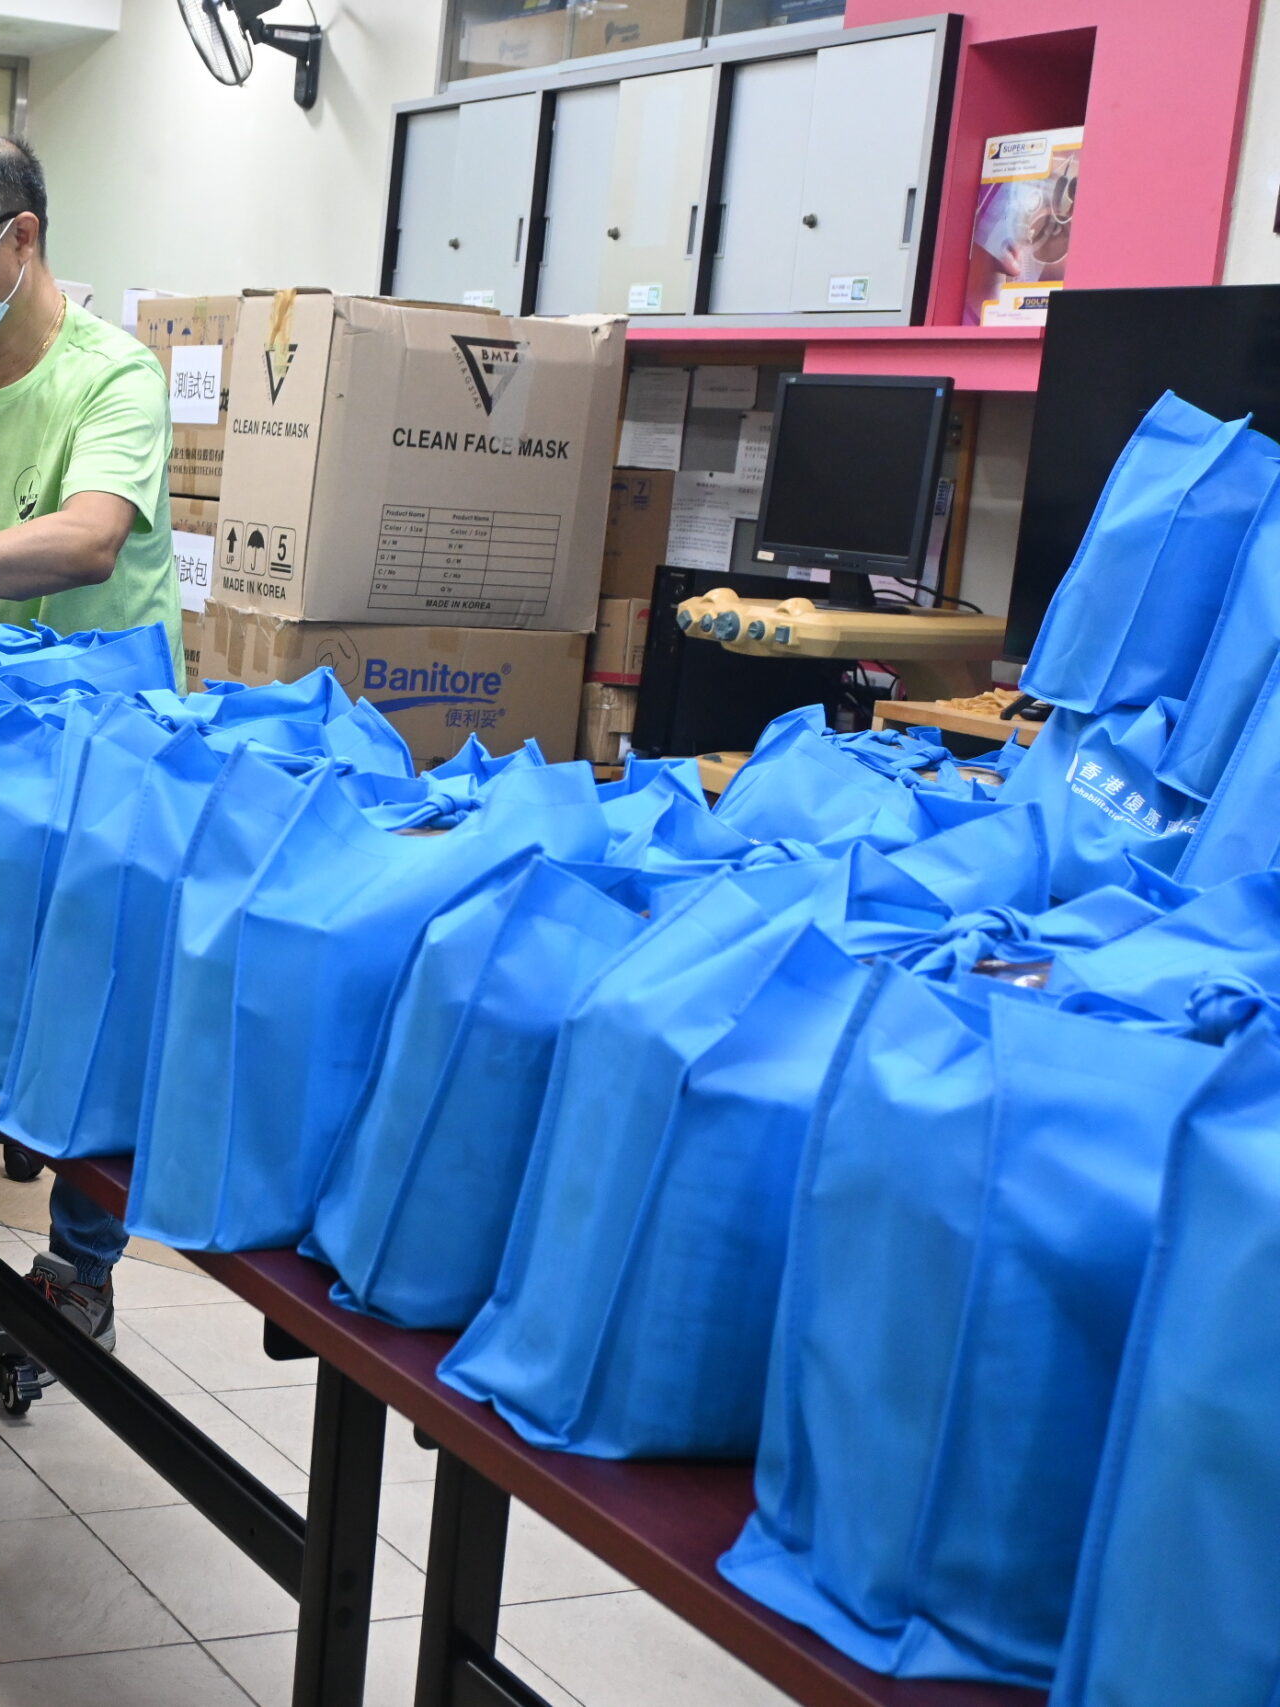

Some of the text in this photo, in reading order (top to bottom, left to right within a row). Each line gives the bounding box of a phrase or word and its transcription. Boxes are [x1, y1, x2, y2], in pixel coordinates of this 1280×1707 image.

[174, 371, 216, 400] 測試包
[233, 418, 310, 439] CLEAN FACE MASK
[392, 427, 570, 459] CLEAN FACE MASK
[385, 509, 408, 518] Product
[450, 528, 468, 536] Color
[277, 534, 287, 562] 5
[226, 555, 235, 565] UP
[223, 576, 286, 600] MADE IN KOREA
[425, 600, 491, 610] MADE IN KOREA
[1079, 761, 1182, 833] 香港復康
